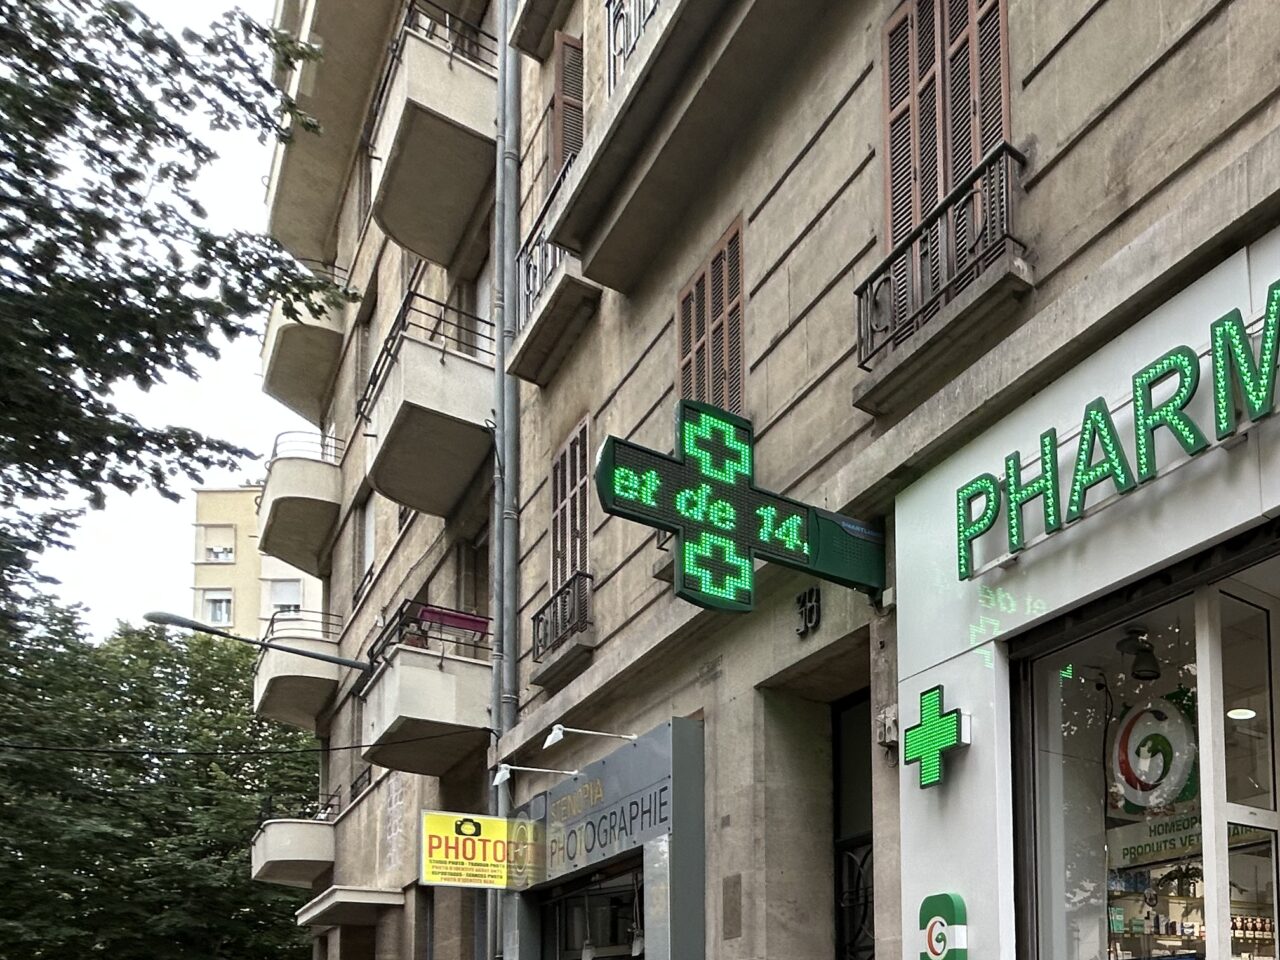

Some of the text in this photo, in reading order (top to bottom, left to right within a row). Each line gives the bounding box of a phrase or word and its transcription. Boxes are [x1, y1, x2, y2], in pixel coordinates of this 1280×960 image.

[613, 466, 661, 507] et
[676, 482, 736, 530] de
[427, 834, 507, 863] PHOTO
[550, 785, 669, 868] PHOTOGRAPHIE
